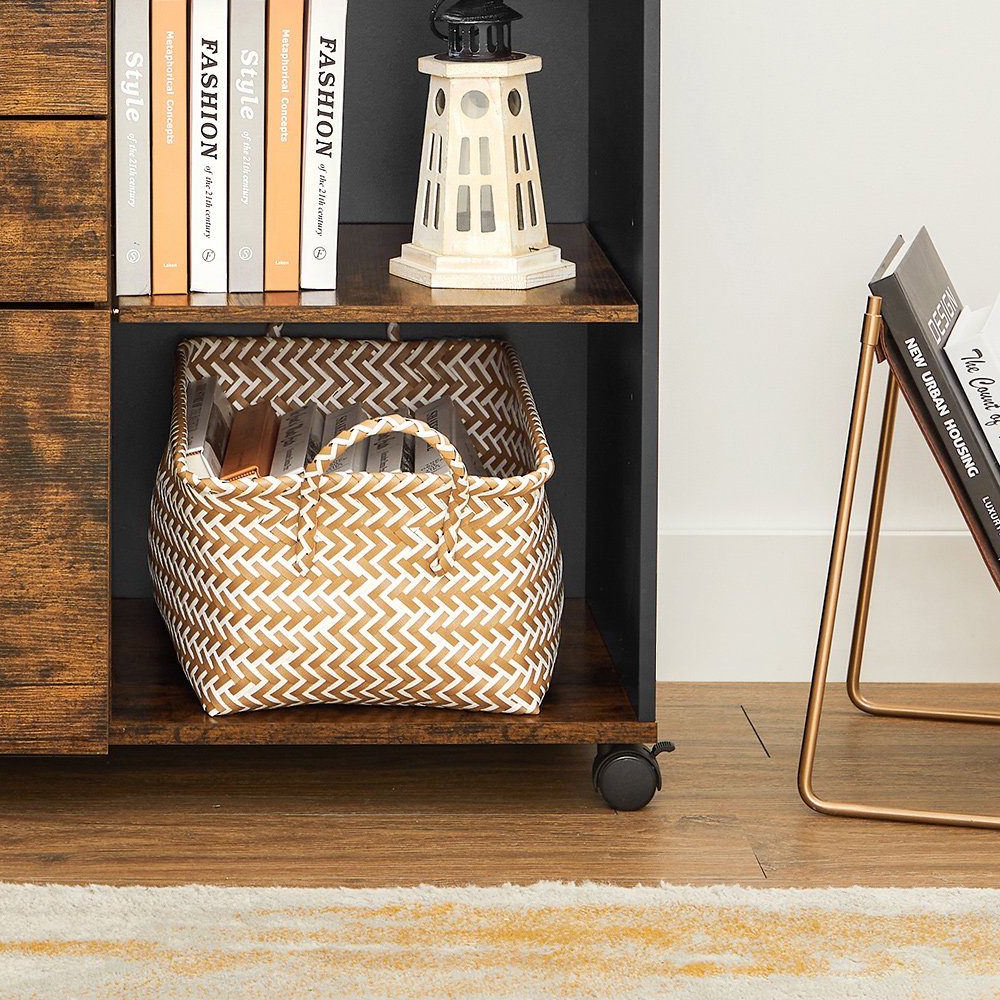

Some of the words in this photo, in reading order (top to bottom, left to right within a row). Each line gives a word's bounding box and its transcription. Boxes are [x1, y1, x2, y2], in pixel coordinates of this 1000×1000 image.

[165, 31, 175, 95] Metaphorical
[280, 29, 290, 93] Metaphorical
[120, 51, 144, 122] Style
[200, 38, 218, 160] FASHION
[235, 49, 259, 120] Style
[316, 36, 337, 158] FASHION
[165, 100, 175, 145] Concepts
[279, 97, 289, 143] Concepts
[127, 132, 137, 144] of
[128, 144, 137, 157] the
[241, 130, 251, 142] of
[242, 142, 251, 155] the
[204, 165, 213, 175] of
[205, 176, 213, 189] the
[318, 163, 327, 173] of
[319, 174, 327, 187] the
[127, 177, 136, 208] century
[240, 175, 250, 205] century
[203, 209, 212, 239] century
[315, 207, 324, 237] century
[927, 286, 958, 345] DESIGN
[960, 348, 986, 374] The
[904, 337, 928, 368] NEW
[921, 370, 951, 417] URBAN
[943, 418, 980, 478] HOUSING
[968, 378, 1000, 411] Count
[982, 496, 1000, 530] LUXUR
